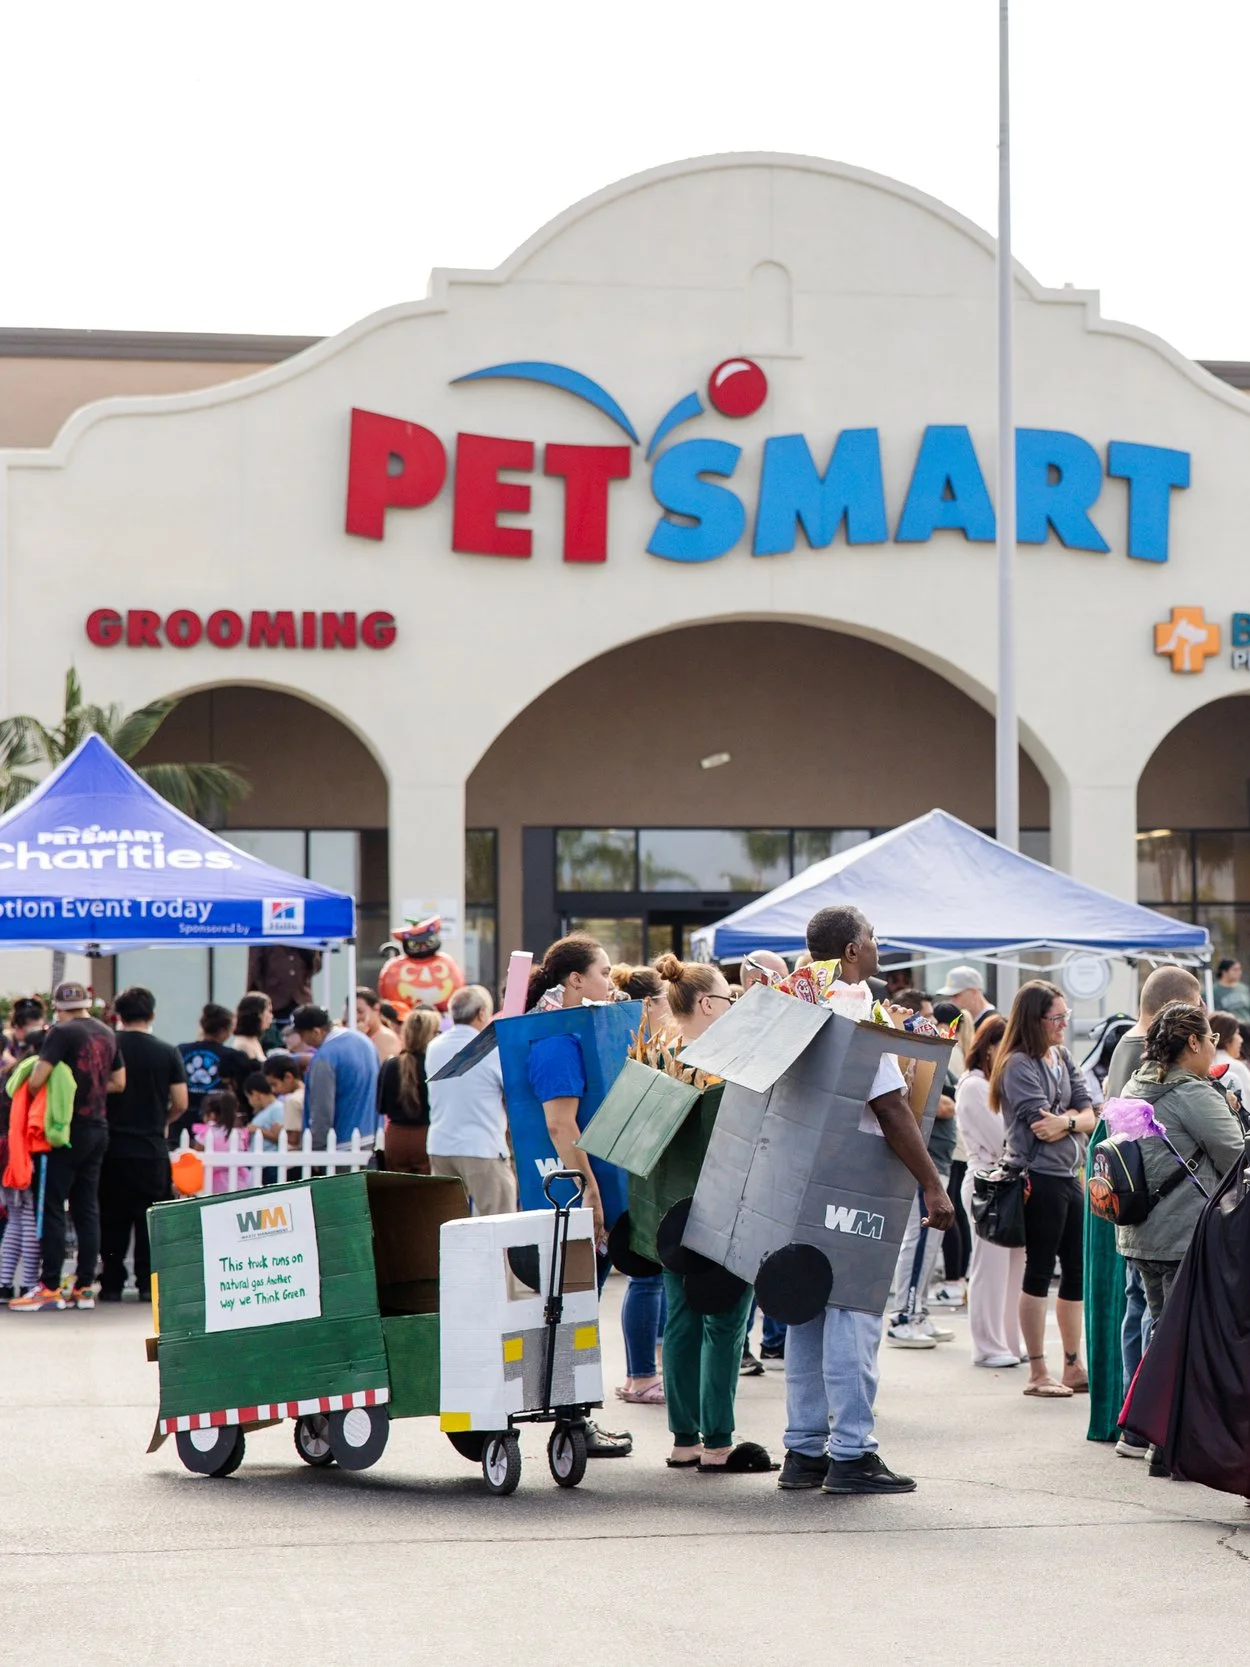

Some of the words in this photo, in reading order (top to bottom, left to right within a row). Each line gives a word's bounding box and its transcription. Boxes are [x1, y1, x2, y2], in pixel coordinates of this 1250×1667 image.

[345, 407, 1191, 564] PETSMART
[86, 608, 397, 649] GROOMING
[37, 829, 164, 845] PETSMART
[61, 897, 132, 919] Event
[136, 897, 213, 924] Today
[179, 922, 236, 935] Sponsored
[236, 923, 251, 936] by
[534, 1157, 565, 1177] W
[236, 1206, 288, 1233] WM
[824, 1204, 885, 1240] WM
[219, 1257, 244, 1272] This
[248, 1254, 268, 1269] truck
[272, 1256, 290, 1266] runs
[291, 1253, 303, 1263] on
[220, 1277, 249, 1291] natural
[220, 1298, 235, 1311] way
[239, 1295, 251, 1306] we
[254, 1290, 280, 1305] Think
